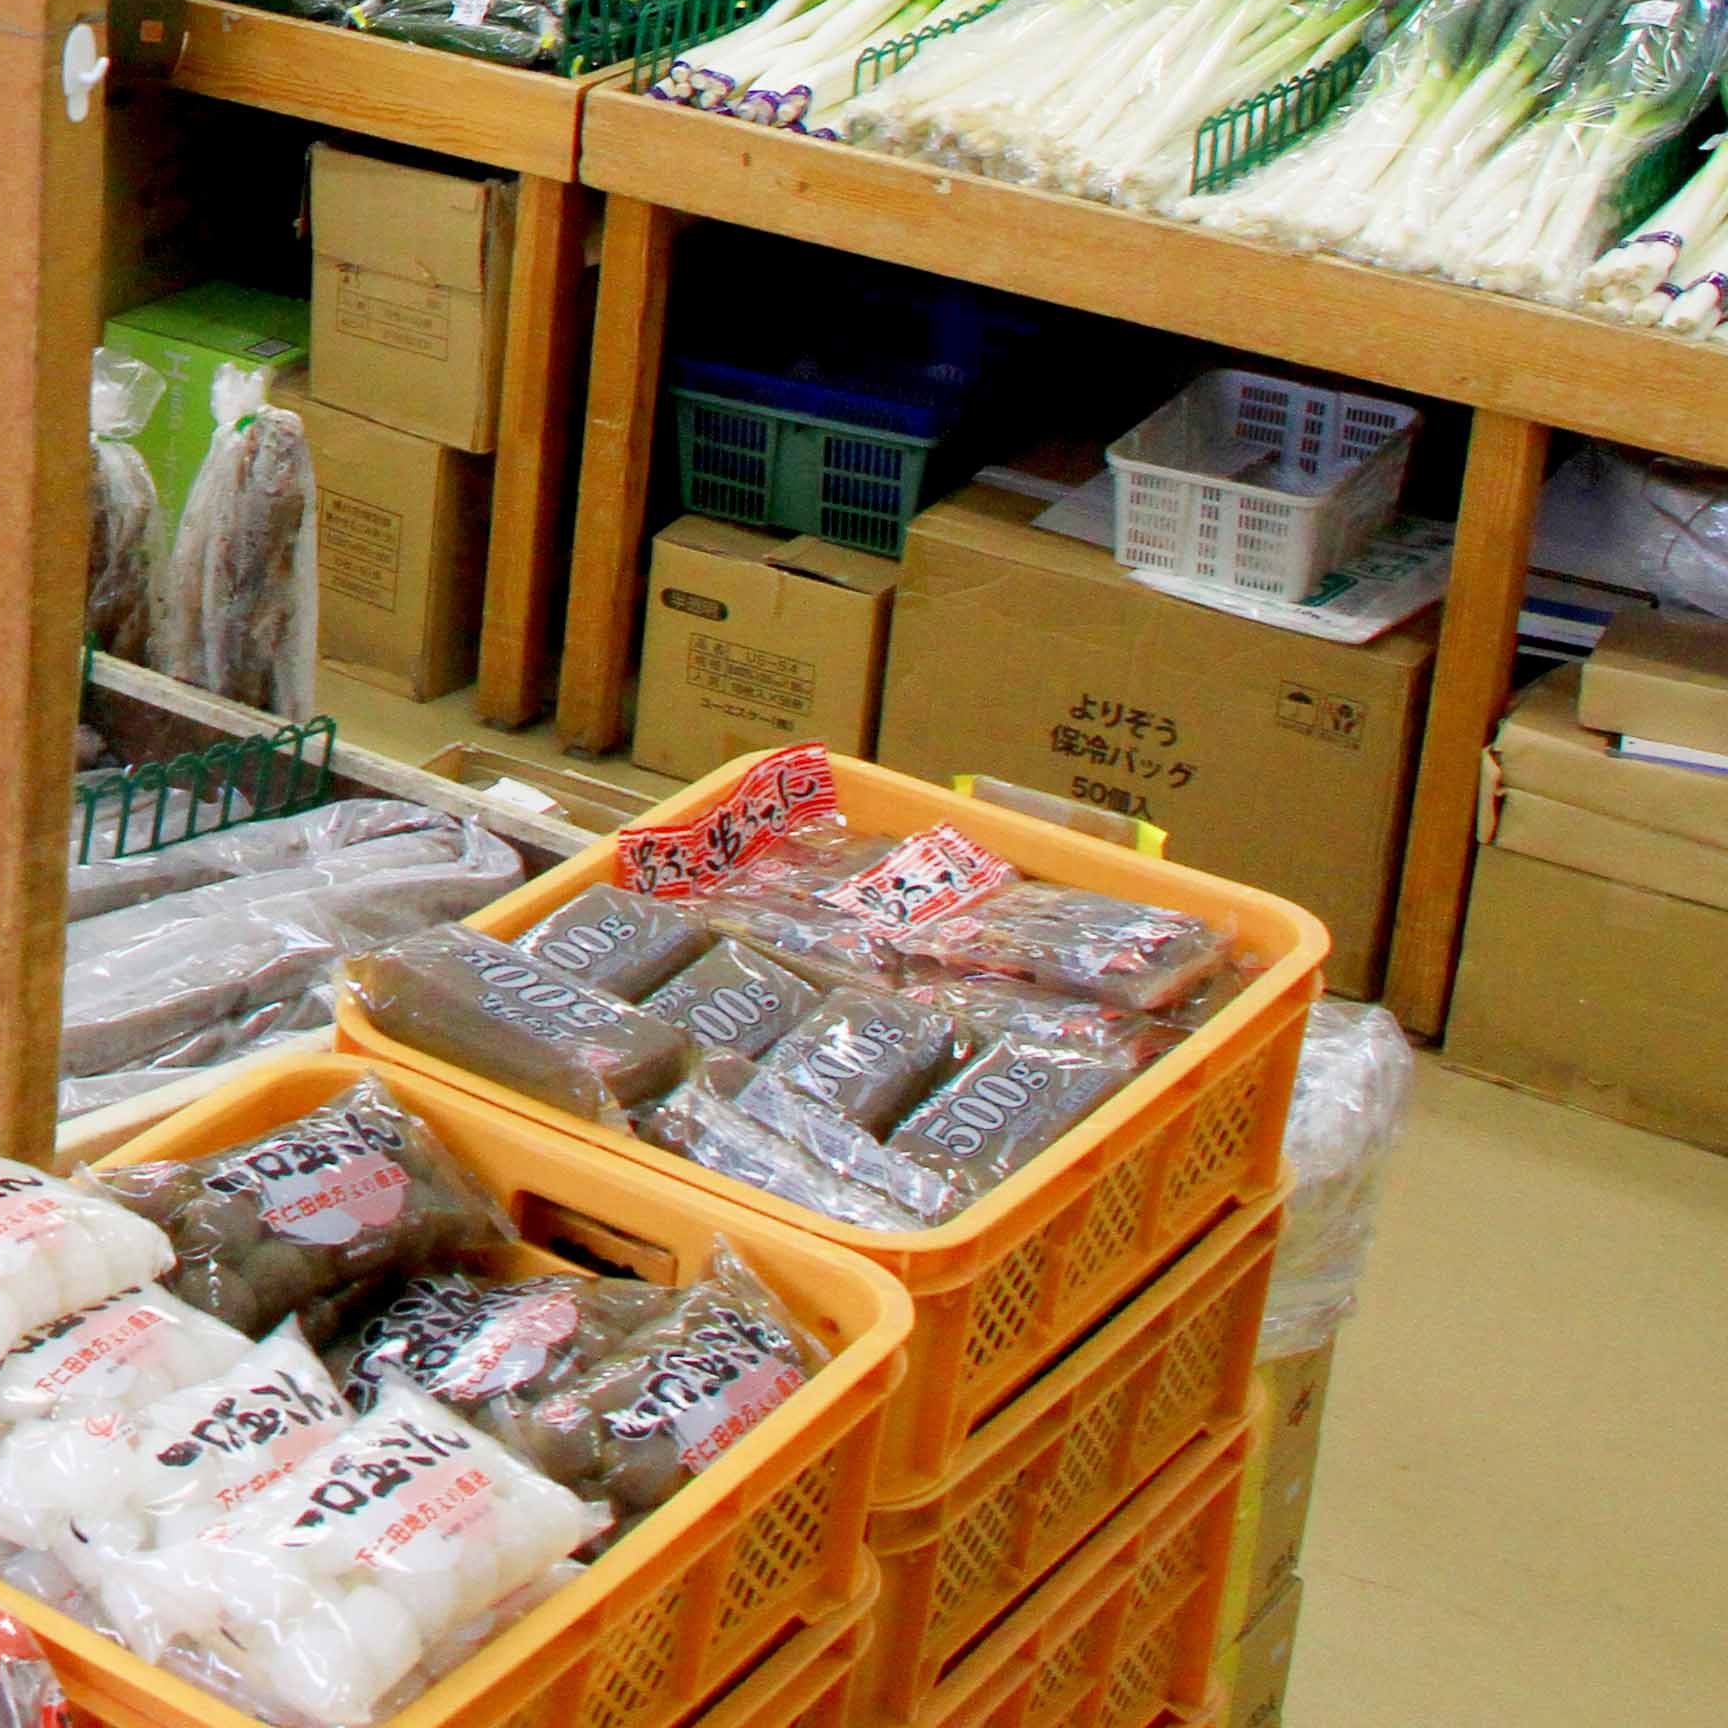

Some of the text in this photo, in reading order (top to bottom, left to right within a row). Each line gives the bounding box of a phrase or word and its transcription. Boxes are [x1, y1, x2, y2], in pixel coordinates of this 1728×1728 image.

[1068, 692, 1179, 748] よりぞう
[1049, 722, 1199, 789] 保冷バッグ
[1071, 775, 1154, 822] 50個入
[543, 915, 637, 971] 00g
[925, 1061, 1049, 1159] 500g
